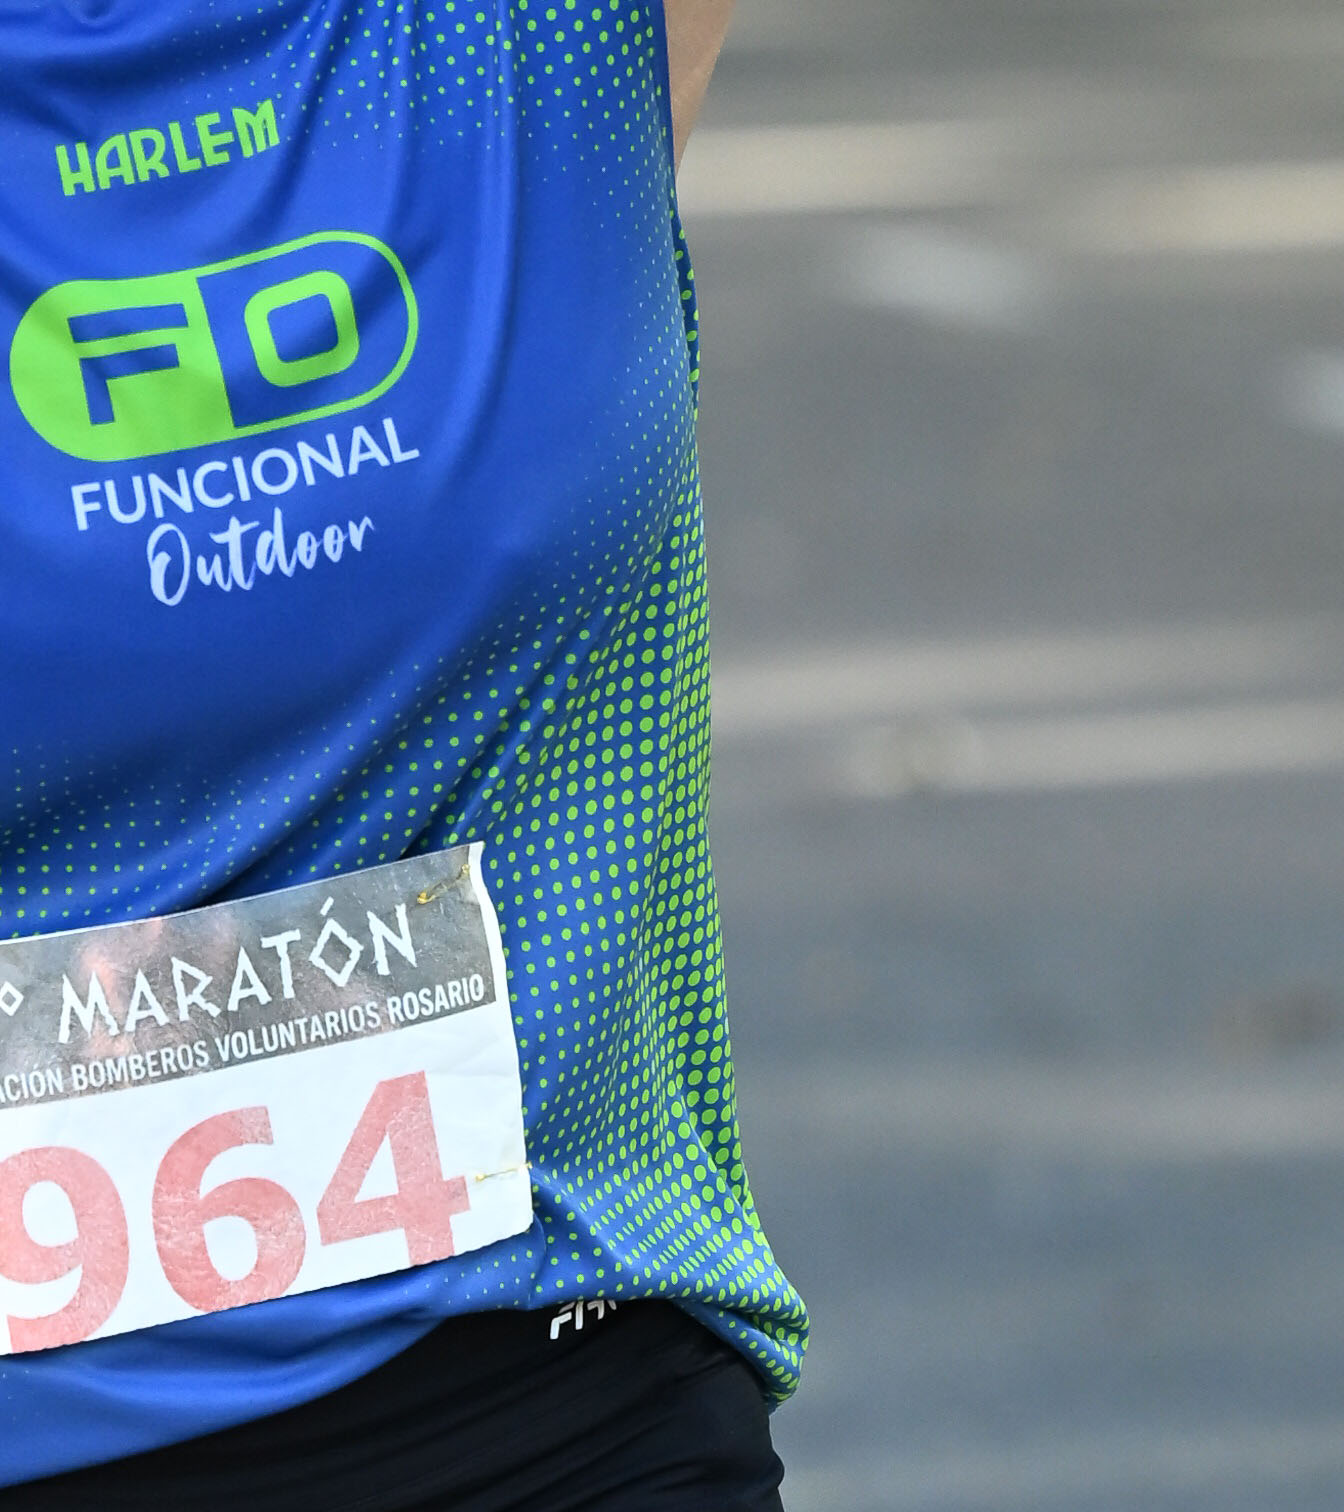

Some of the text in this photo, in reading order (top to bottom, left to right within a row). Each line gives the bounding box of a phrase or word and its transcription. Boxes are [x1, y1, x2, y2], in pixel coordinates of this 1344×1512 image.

[56, 99, 280, 196] HARLEM
[71, 417, 419, 531] FUNCIONAL
[146, 507, 375, 606] Outdoor
[58, 896, 418, 1044] MARATÓN
[71, 1040, 210, 1091] BOMBEROS
[214, 1001, 381, 1063] VOLUNTARIOS
[387, 974, 485, 1025] ROSARIO
